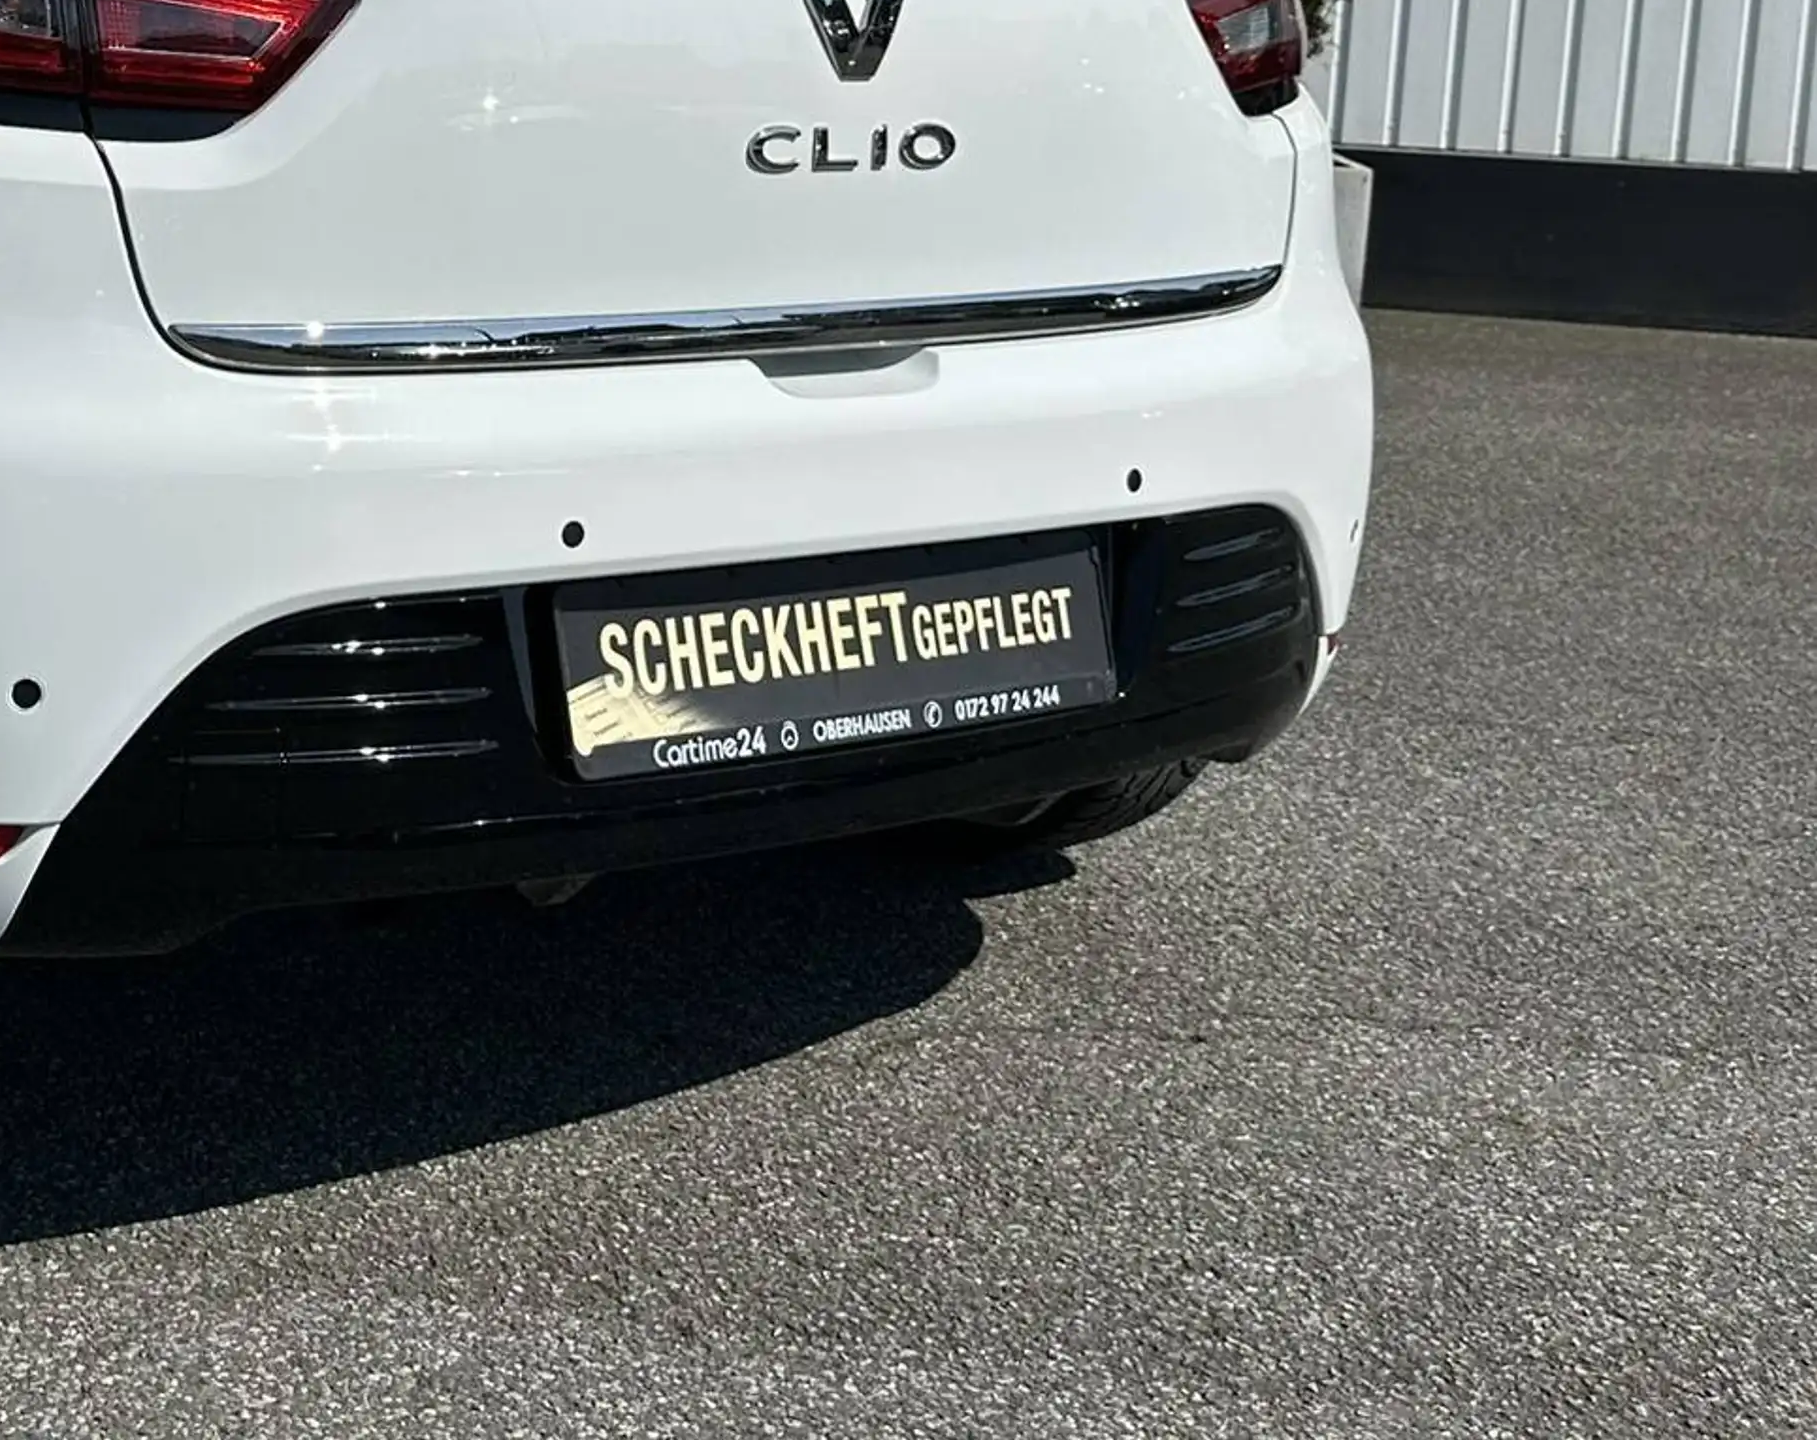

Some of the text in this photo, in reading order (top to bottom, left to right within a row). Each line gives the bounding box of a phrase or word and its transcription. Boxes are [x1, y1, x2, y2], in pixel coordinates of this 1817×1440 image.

[745, 123, 956, 175] CLIO
[813, 708, 911, 742] OBERHAUSEN
[954, 700, 987, 721] 0172
[989, 694, 1009, 714] 97
[1011, 691, 1031, 712] 24
[1032, 685, 1060, 708] 244
